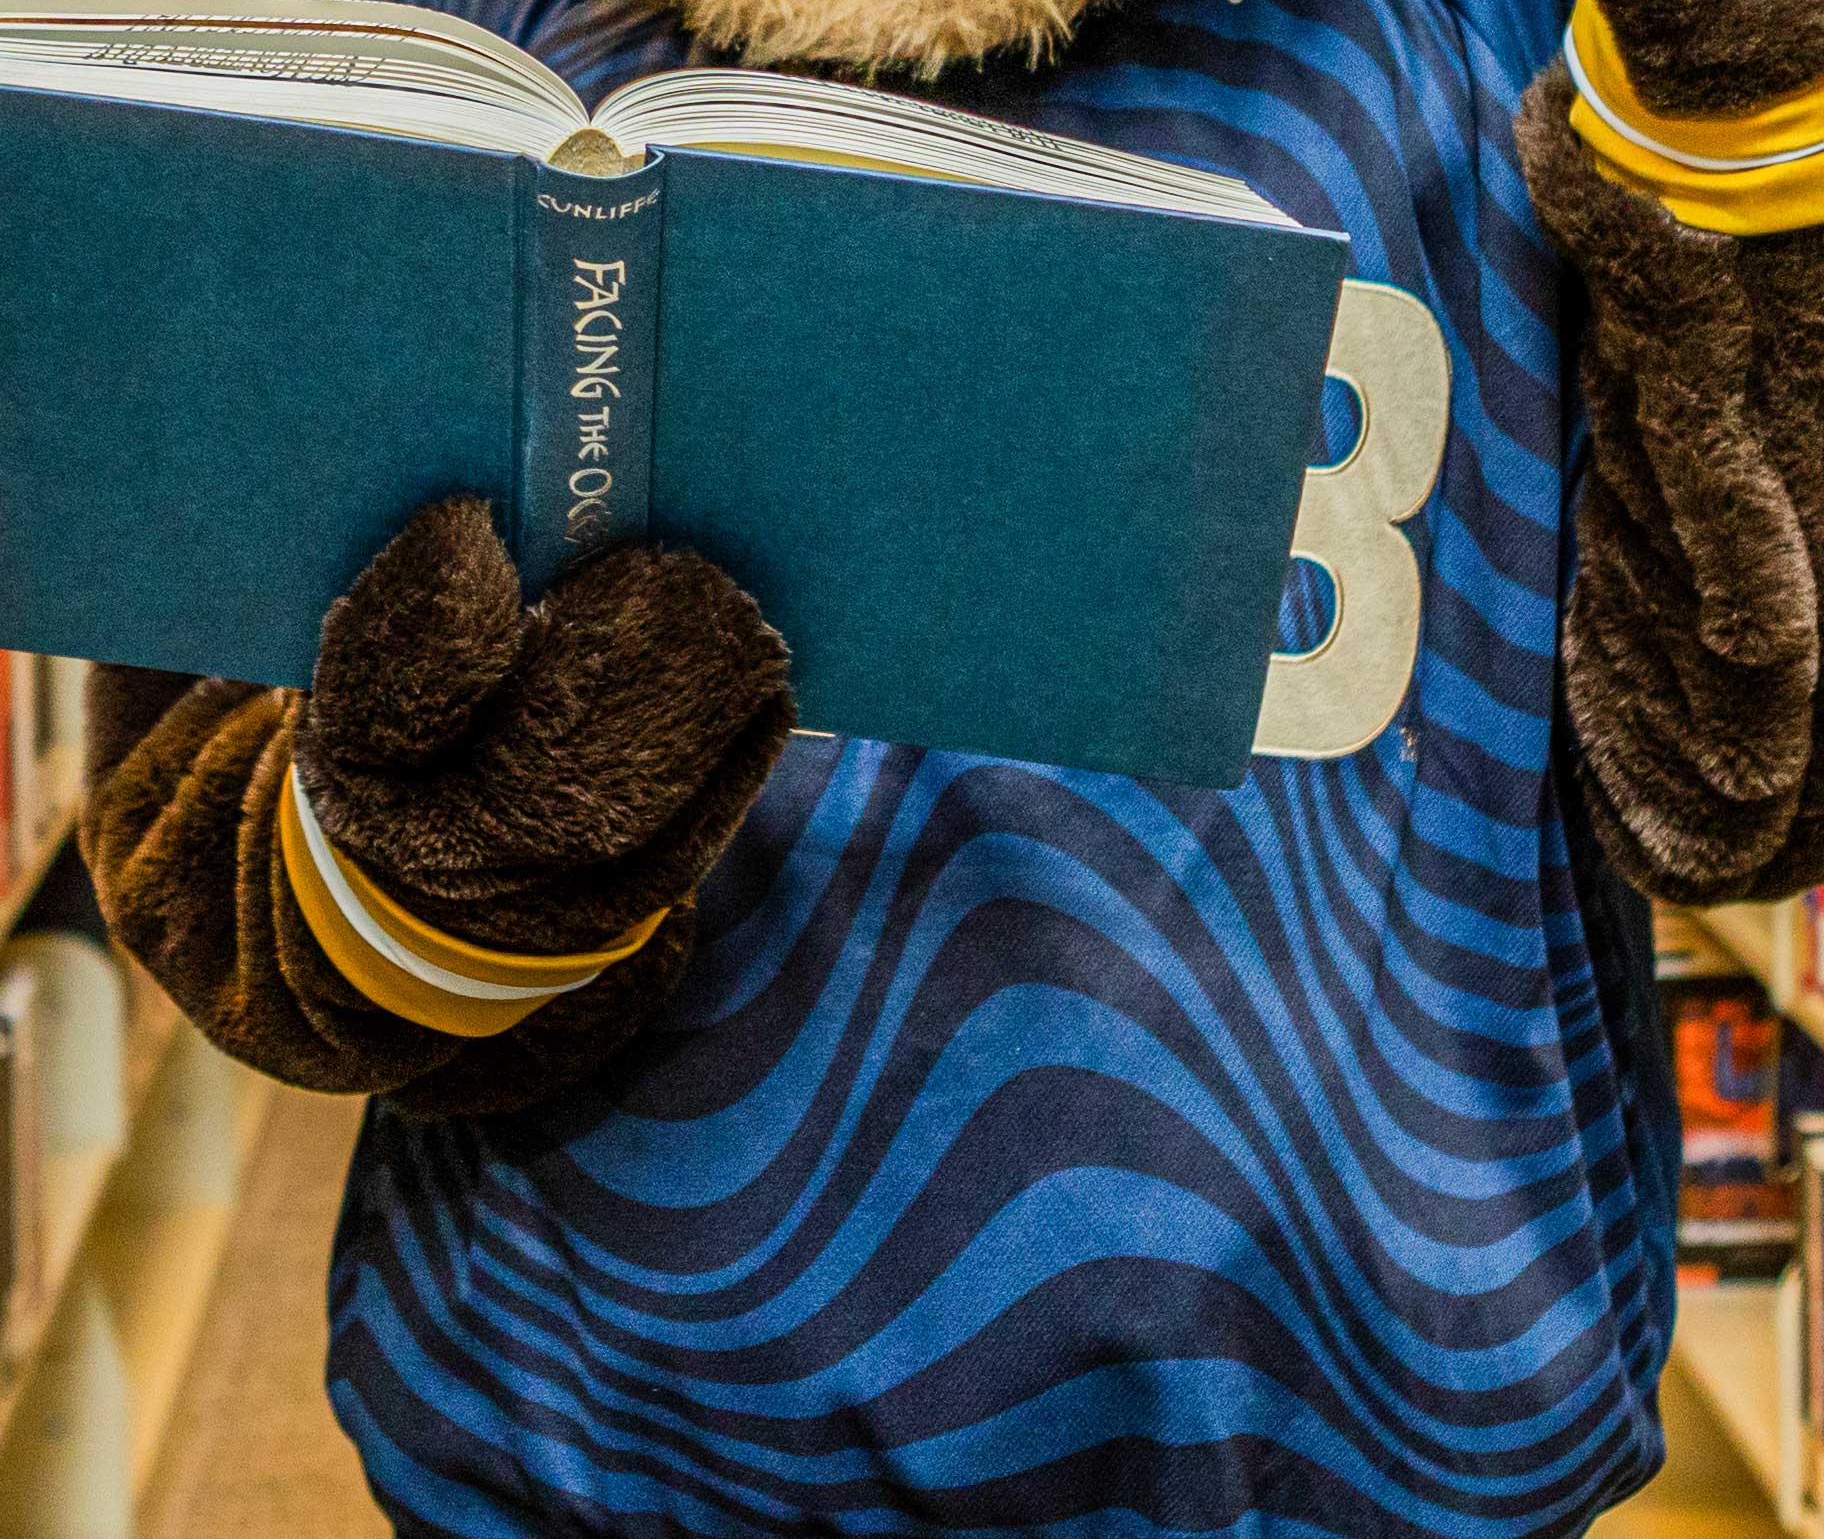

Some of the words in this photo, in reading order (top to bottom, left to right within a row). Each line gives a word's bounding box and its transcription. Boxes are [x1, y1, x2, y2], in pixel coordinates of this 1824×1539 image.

[535, 188, 662, 222] CUNLIFFE
[570, 258, 626, 399] FACING
[577, 406, 610, 462] THE
